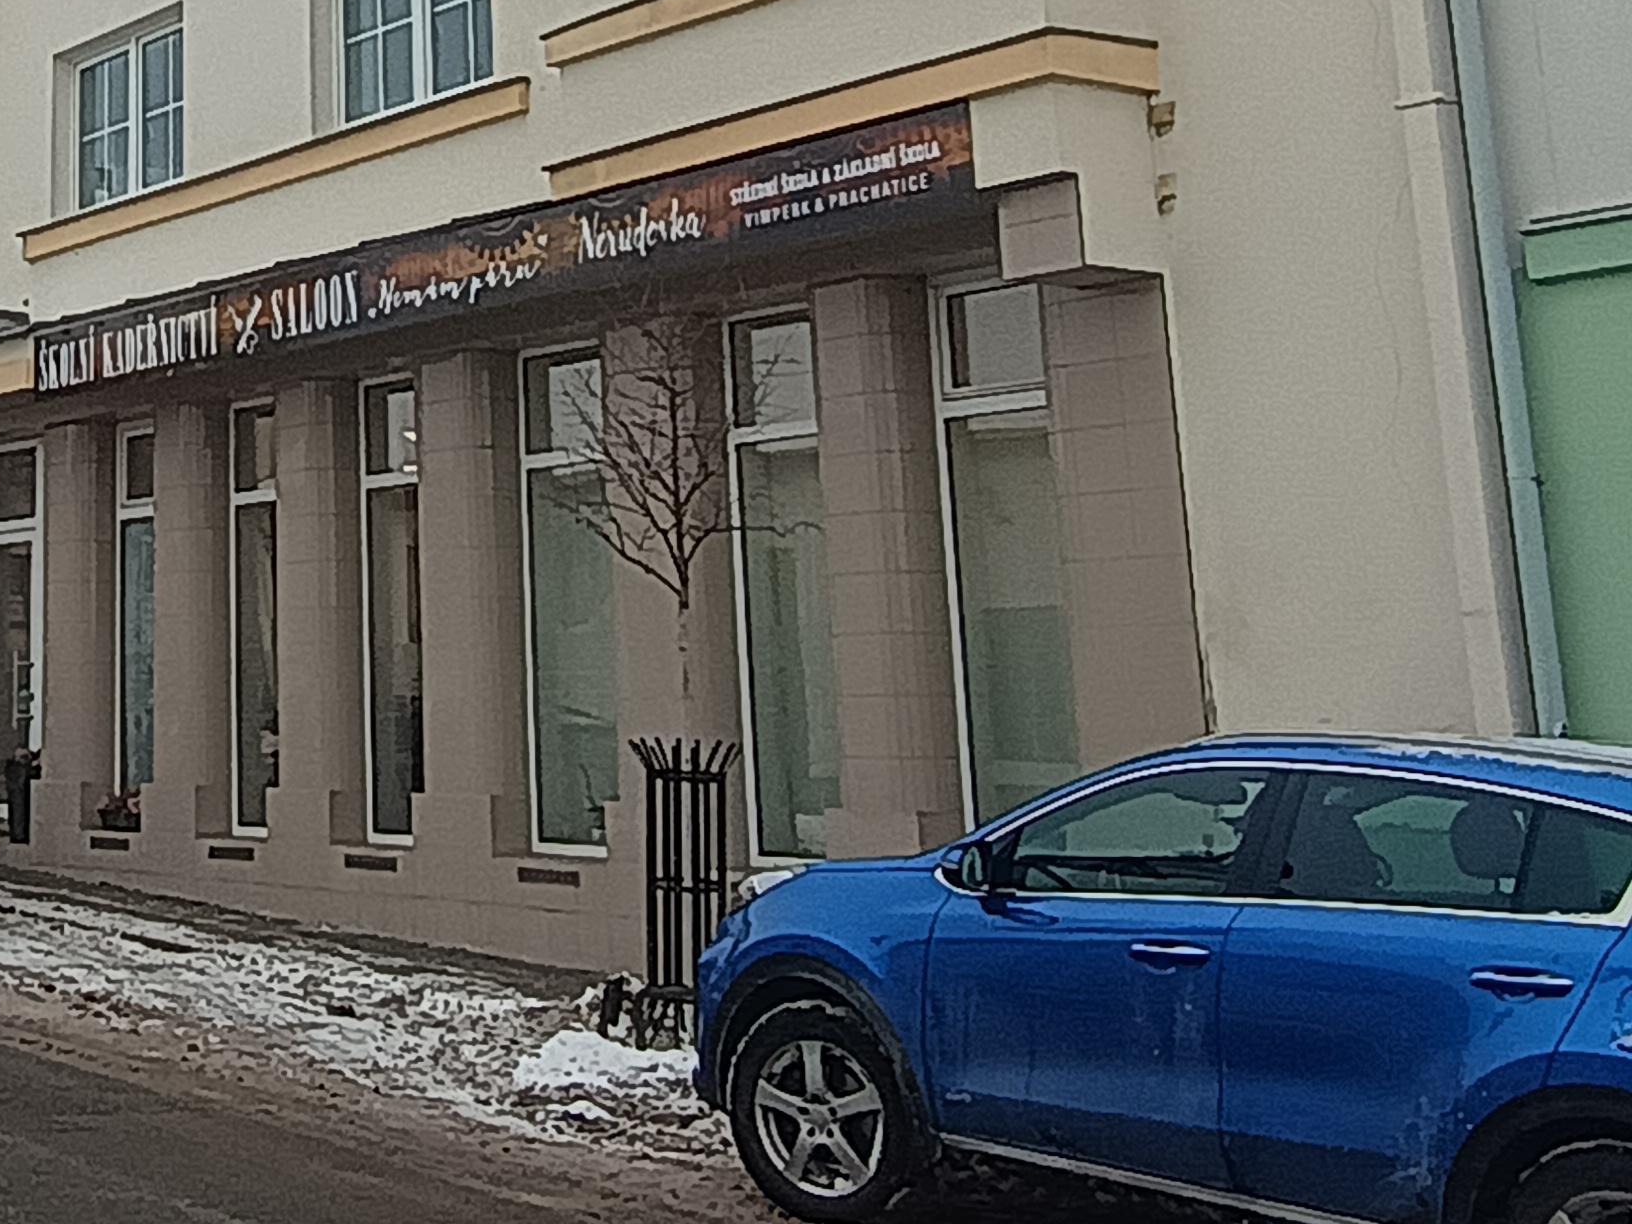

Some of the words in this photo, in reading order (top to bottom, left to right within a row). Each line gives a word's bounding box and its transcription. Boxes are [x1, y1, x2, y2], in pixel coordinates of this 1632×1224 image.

[744, 201, 811, 228] VIMPERK
[829, 172, 929, 210] PRACHATICE
[270, 270, 358, 341] SALOON
